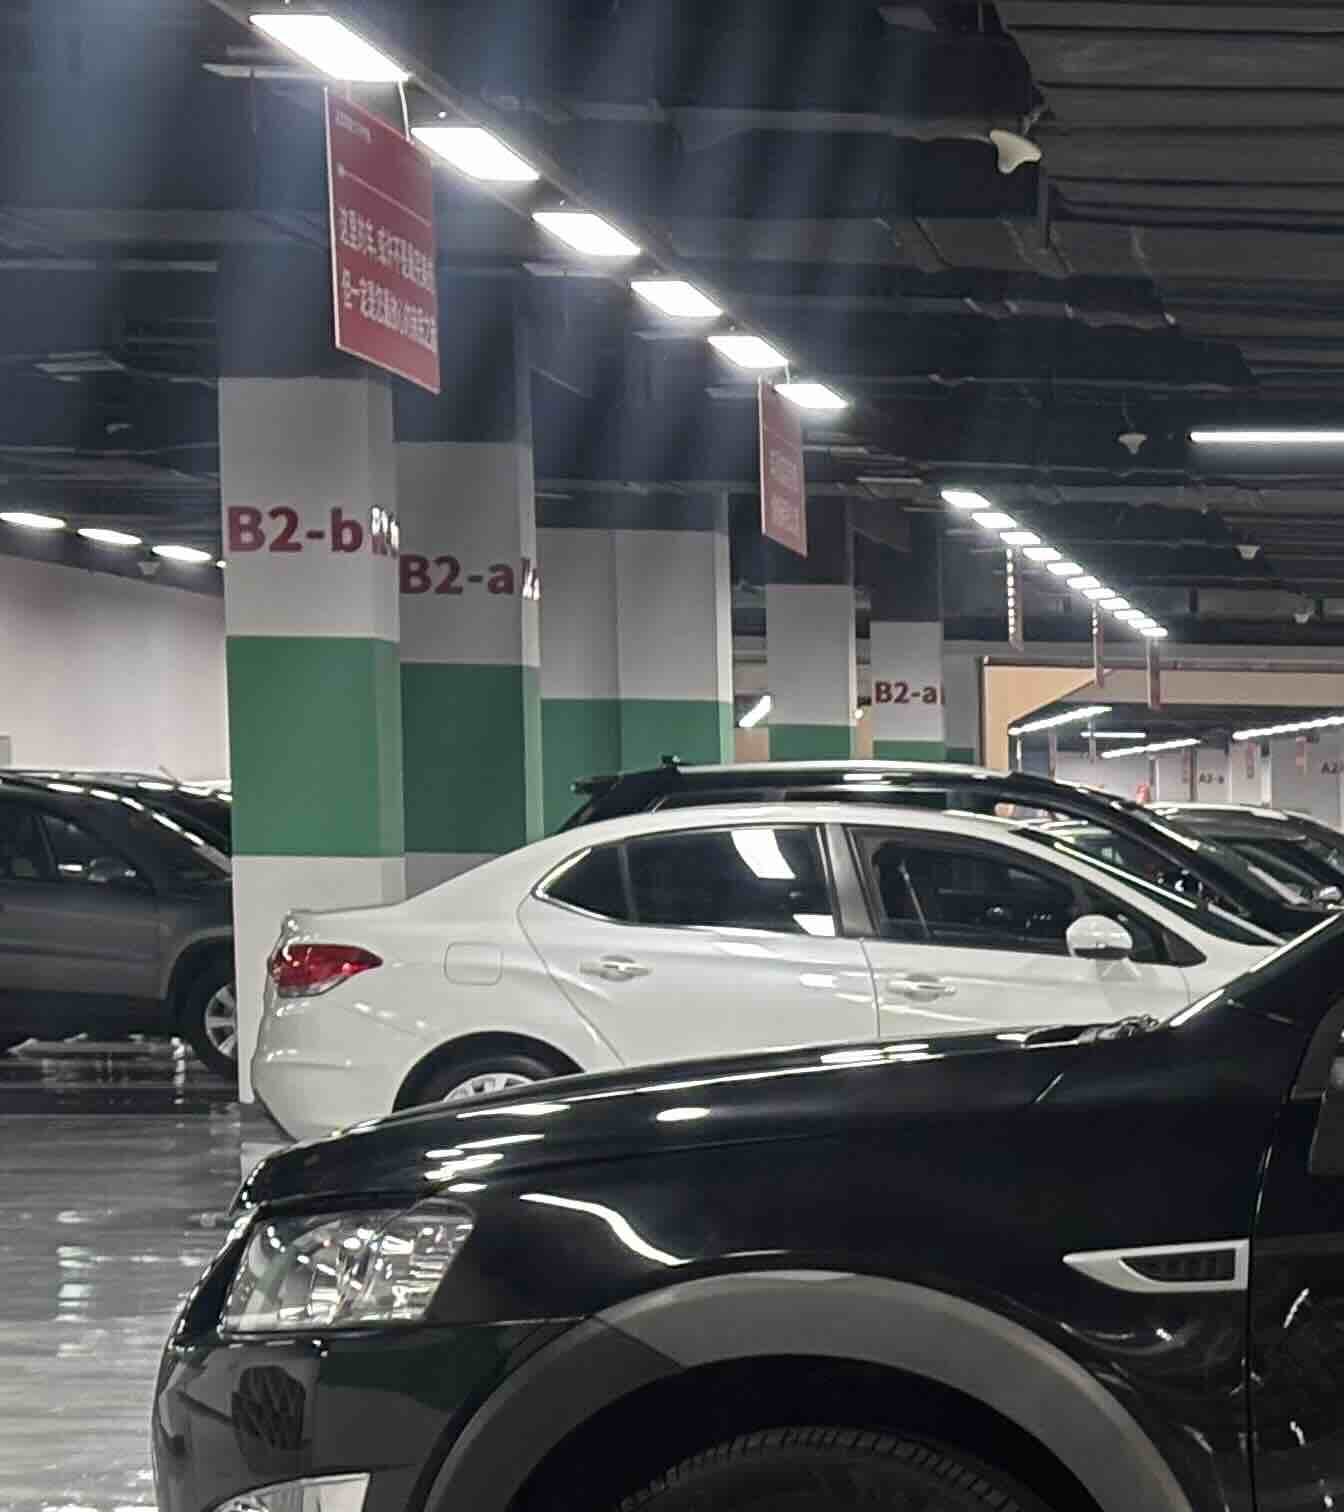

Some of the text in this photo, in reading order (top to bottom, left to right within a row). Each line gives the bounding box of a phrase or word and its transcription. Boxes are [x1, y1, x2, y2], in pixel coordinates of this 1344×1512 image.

[228, 506, 364, 552] B2-b
[400, 554, 515, 595] B2-a
[875, 681, 938, 704] B2-a
